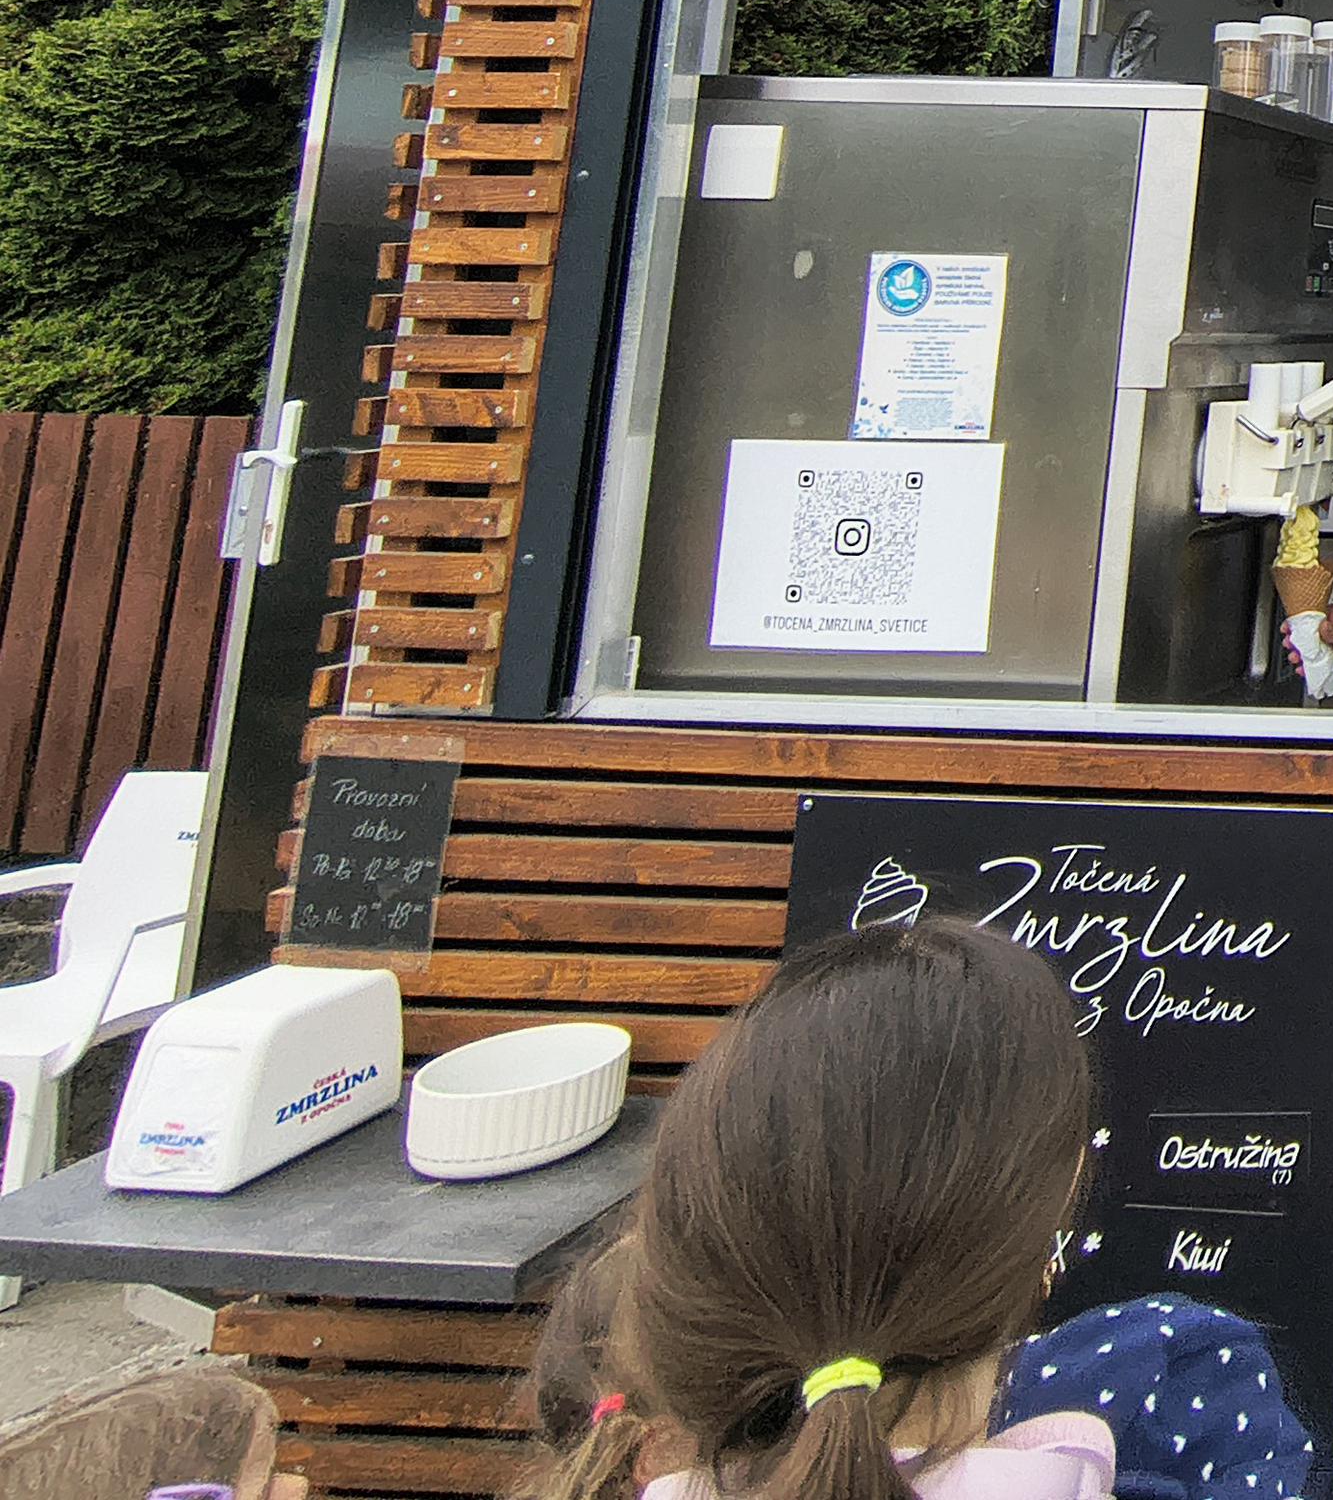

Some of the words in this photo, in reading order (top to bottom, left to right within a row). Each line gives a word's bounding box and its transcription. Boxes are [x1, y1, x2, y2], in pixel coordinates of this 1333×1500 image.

[763, 614, 929, 634] @TOCENA_ZMRZLINA_SVETICE
[1051, 844, 1161, 893] Točená
[1125, 967, 1256, 1037] Opočna
[275, 1064, 379, 1125] ZMRZLINA
[1158, 1135, 1301, 1171] Ostružina
